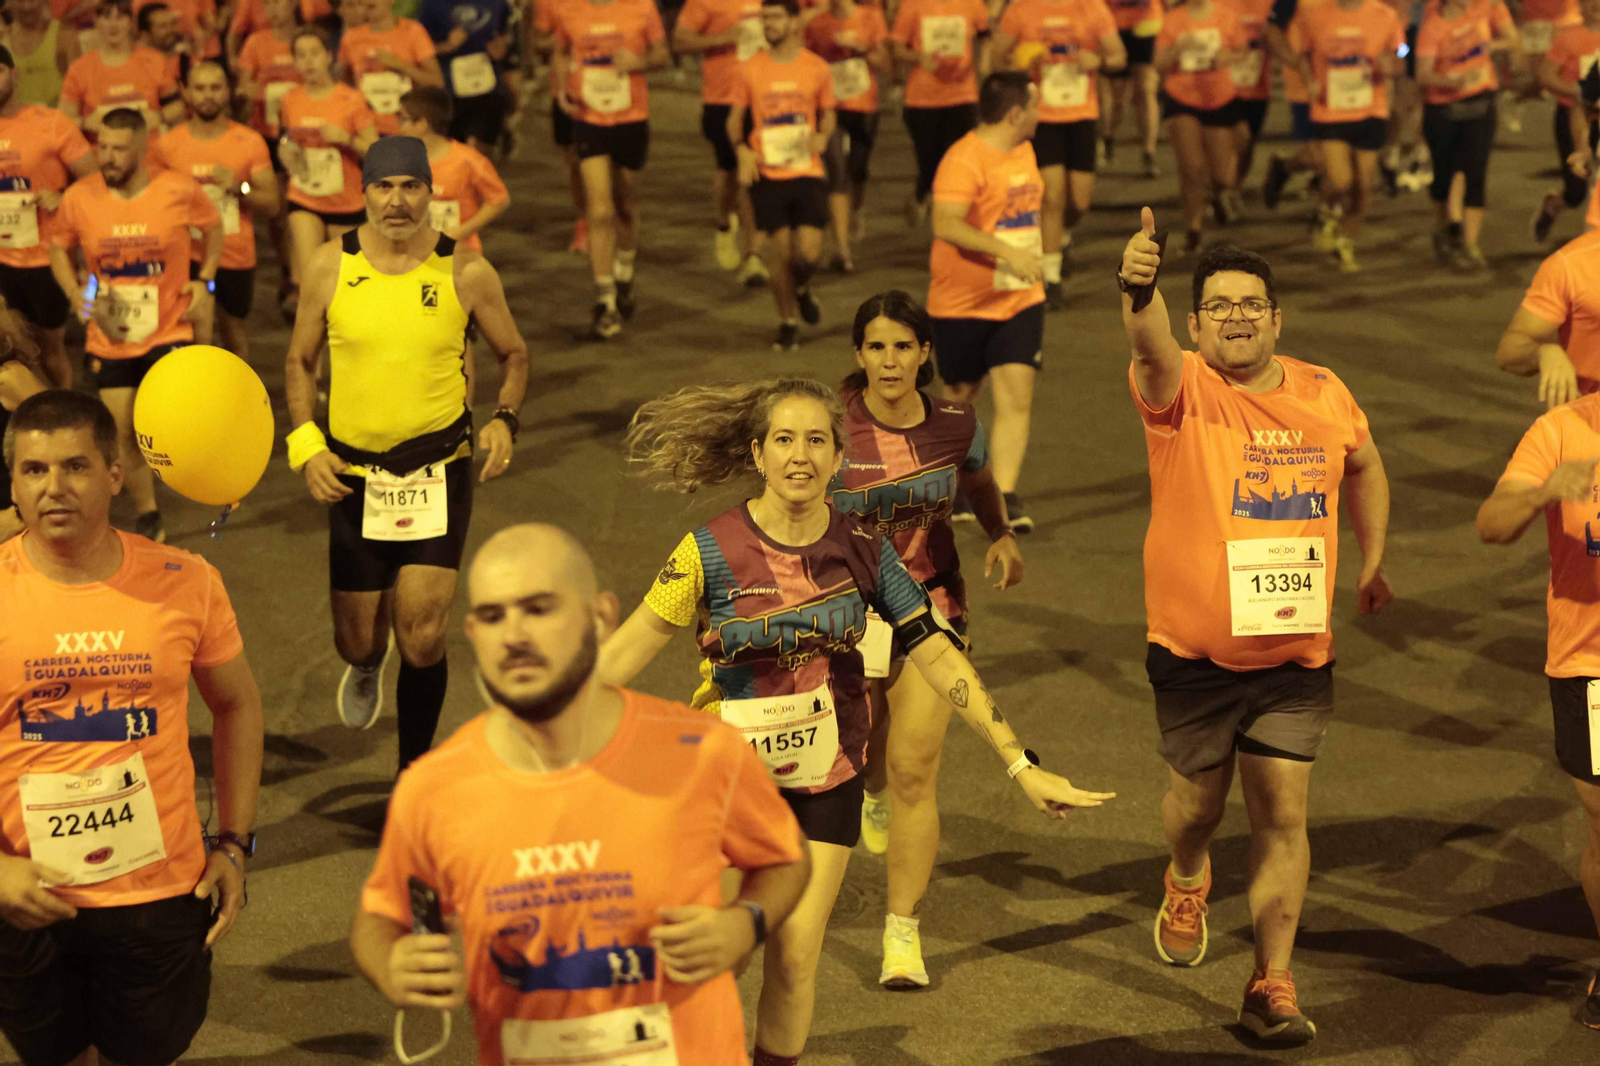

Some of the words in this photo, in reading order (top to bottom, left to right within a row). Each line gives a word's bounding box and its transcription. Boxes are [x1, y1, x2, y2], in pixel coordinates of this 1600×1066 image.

[1252, 429, 1304, 446] XXXV
[1248, 453, 1327, 466] GUDALQUIVIR
[1277, 447, 1325, 455] NOCTURNA
[381, 488, 428, 506] 11871
[1233, 509, 1250, 517] 2025
[1250, 572, 1313, 594] 13394
[54, 630, 125, 654] XXXV
[24, 656, 81, 669] CARRERA
[87, 653, 152, 664] NOCTURNA
[34, 663, 153, 680] GUADALQUIVIR
[48, 802, 135, 838] 22444
[514, 839, 602, 877] XXXV
